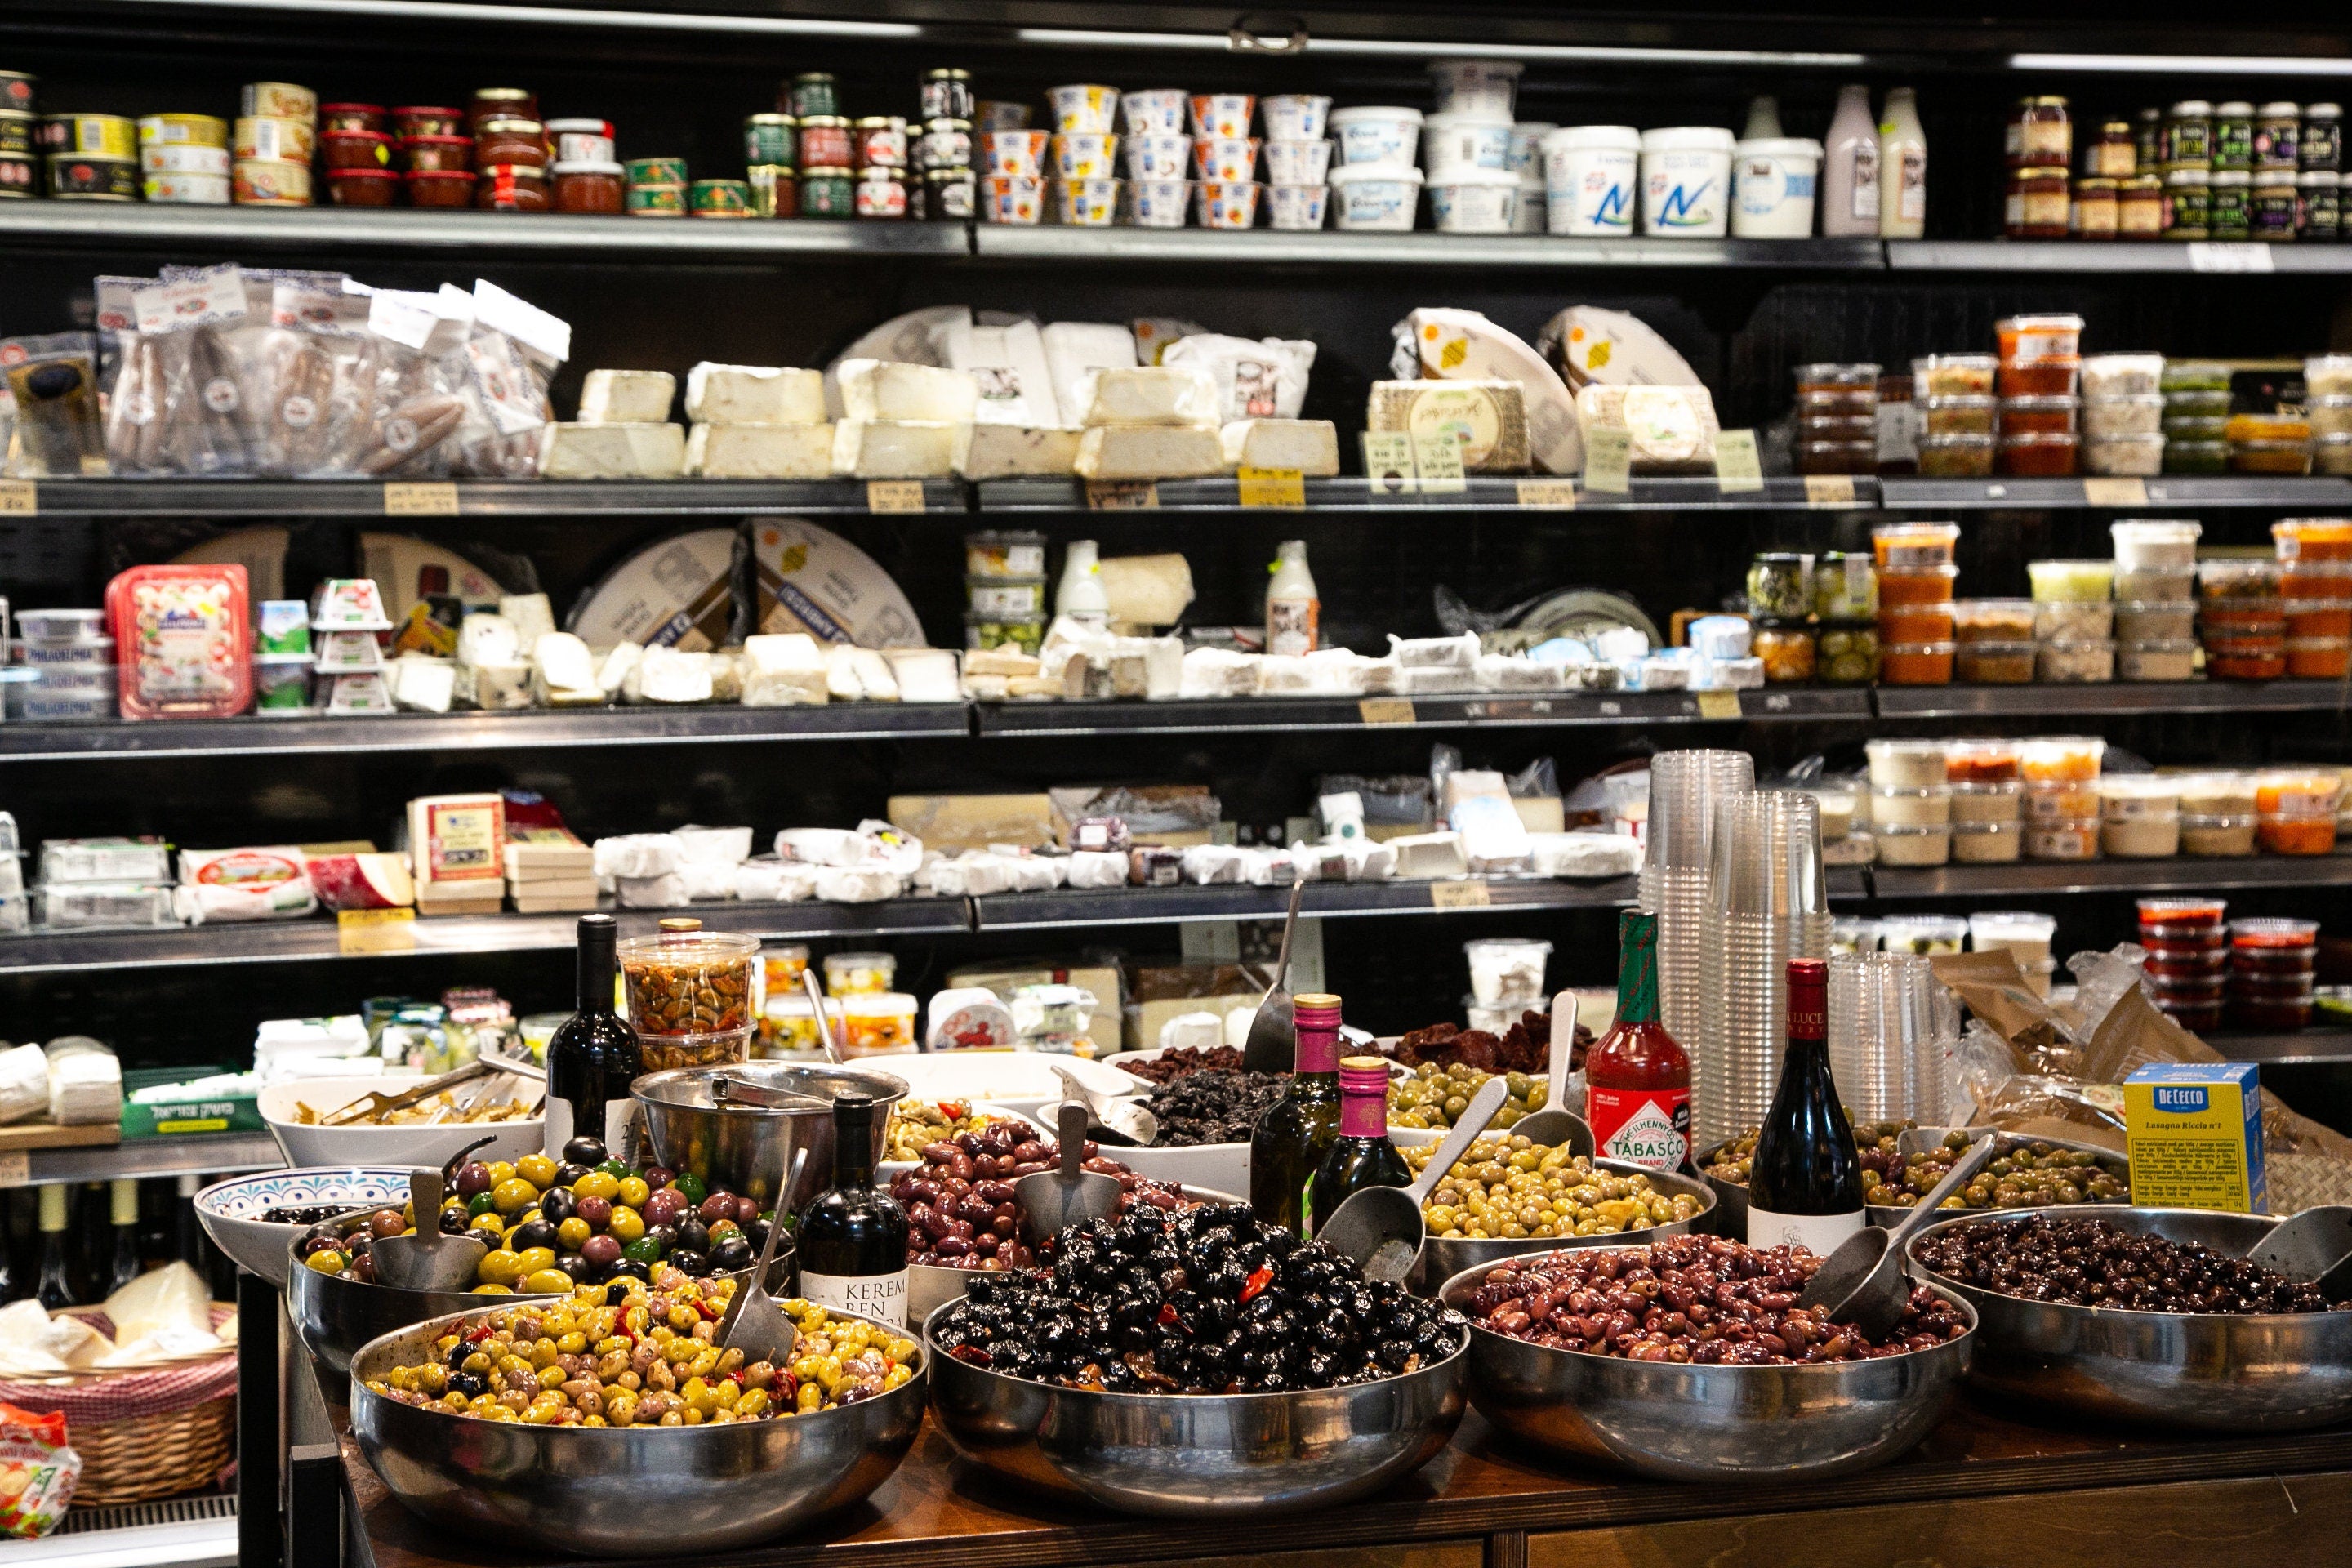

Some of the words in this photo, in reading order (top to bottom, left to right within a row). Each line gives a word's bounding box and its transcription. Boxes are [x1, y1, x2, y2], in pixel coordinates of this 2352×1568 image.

[2173, 1089, 2203, 1104] CECCO
[2145, 1121, 2180, 1130] Lasagna
[2182, 1121, 2207, 1129] Riccia
[1612, 1139, 1683, 1156] TABASCO
[846, 1277, 905, 1299] KEREM
